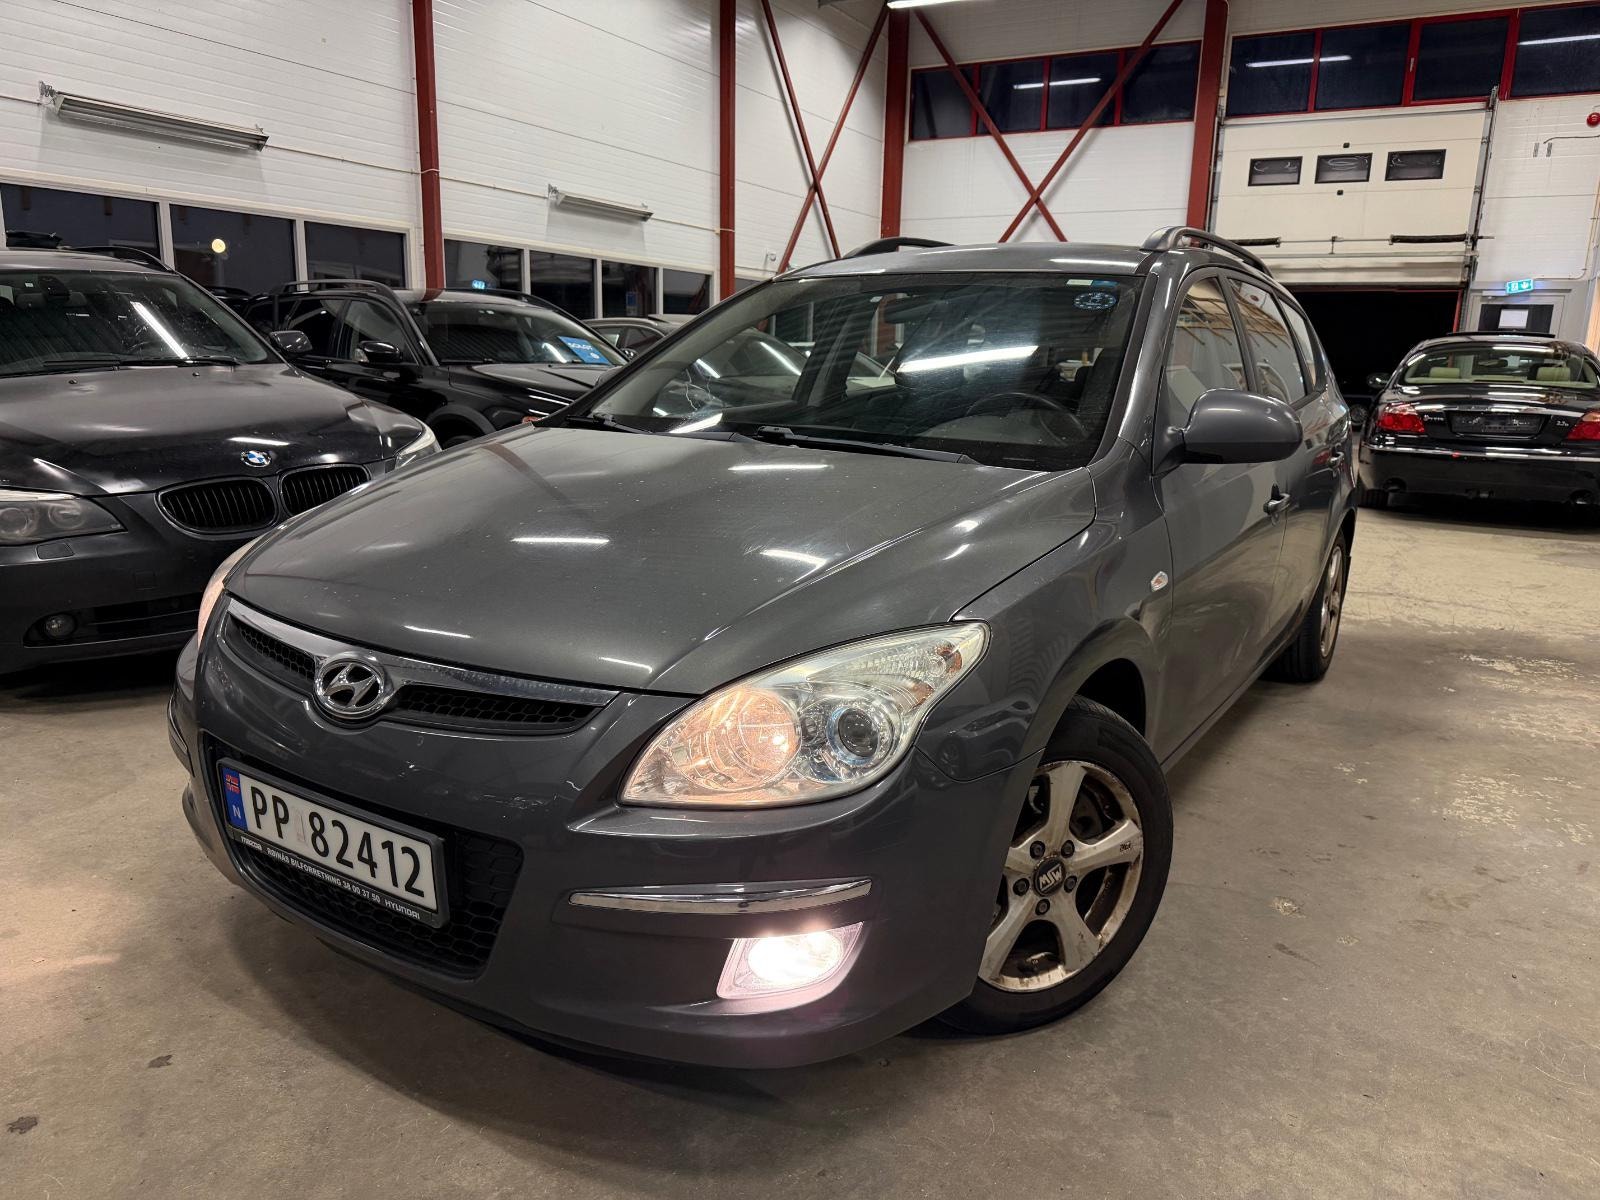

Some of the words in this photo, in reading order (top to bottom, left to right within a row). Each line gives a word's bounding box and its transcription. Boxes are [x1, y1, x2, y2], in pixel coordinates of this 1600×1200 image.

[232, 804, 242, 820] N
[250, 785, 290, 840] PP
[308, 811, 425, 898] 82412
[290, 858, 342, 886] BILFORRETNING
[361, 888, 371, 899] 37
[371, 893, 381, 904] 50
[384, 900, 421, 920] HYUNDAI
[1039, 863, 1063, 892] MSW
